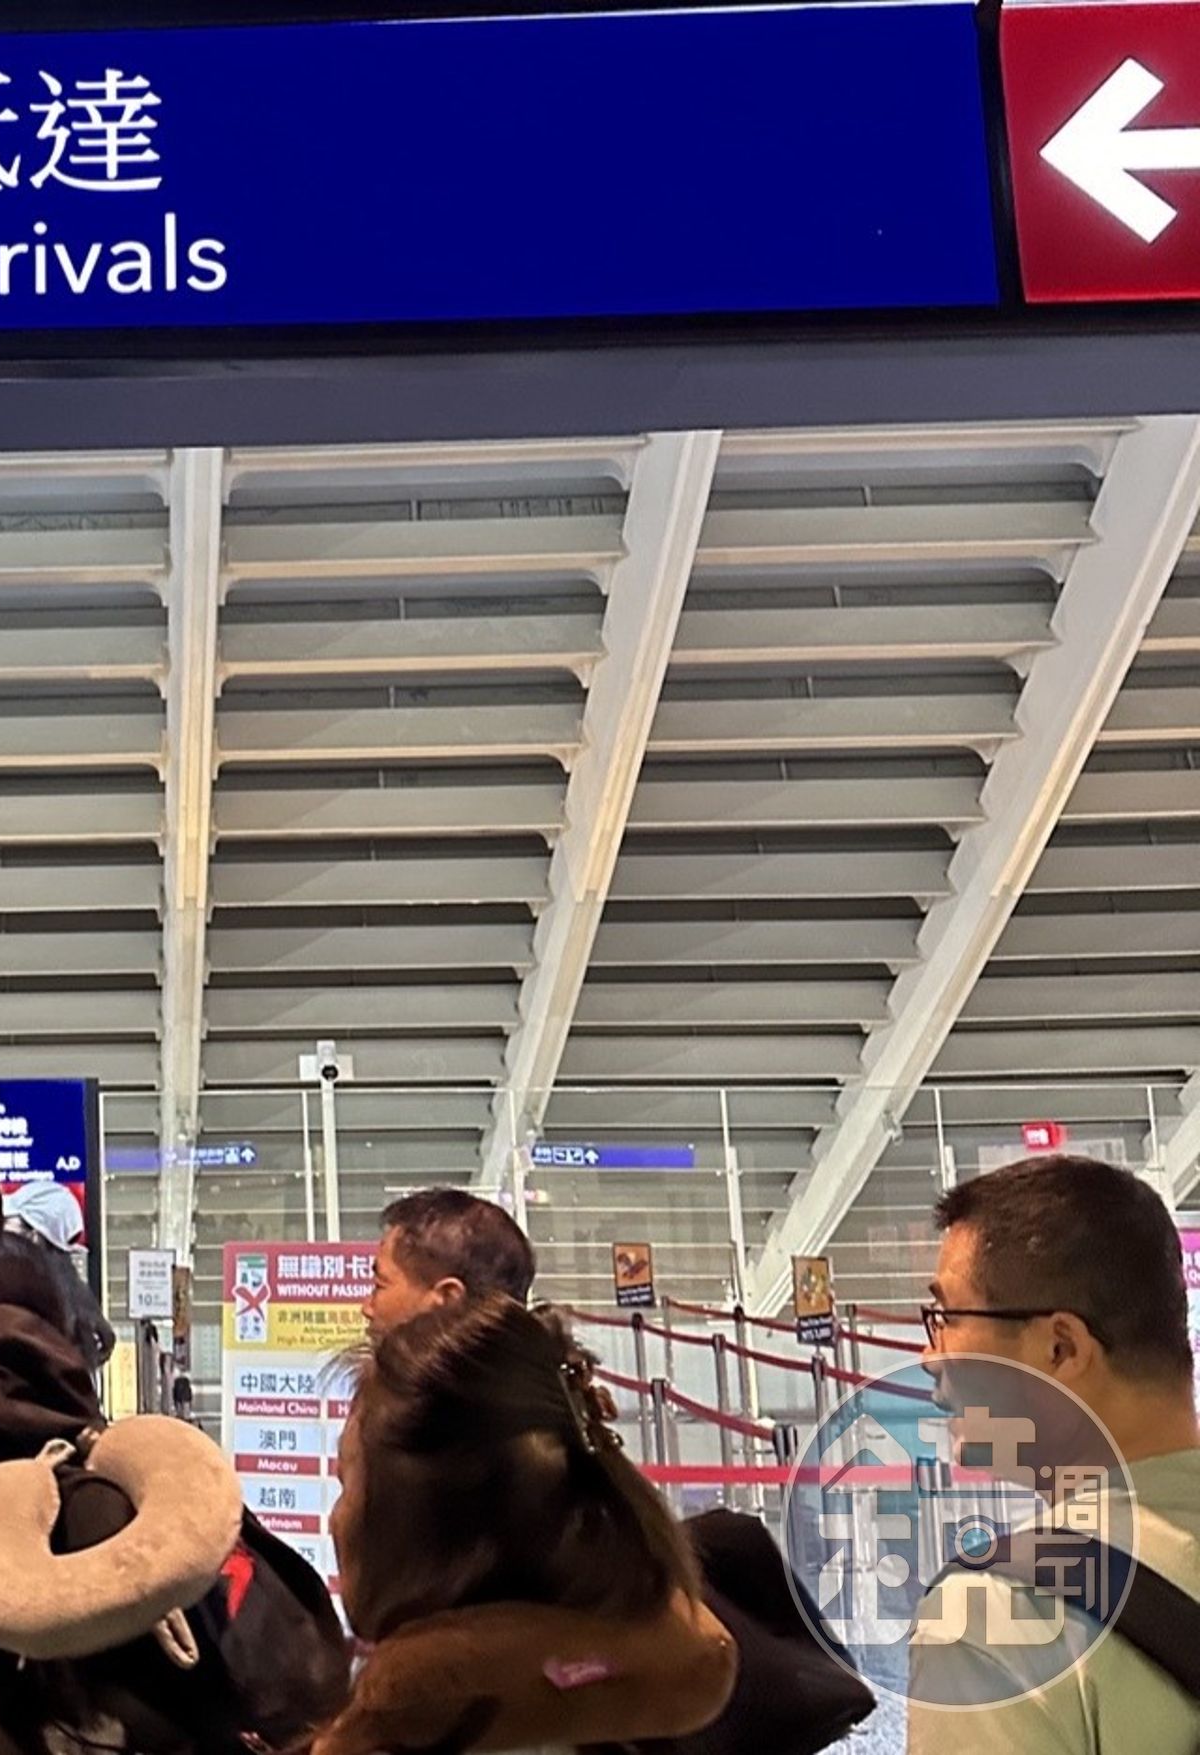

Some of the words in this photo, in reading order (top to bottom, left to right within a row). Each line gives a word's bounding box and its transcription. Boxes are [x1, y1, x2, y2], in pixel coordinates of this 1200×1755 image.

[277, 1284, 330, 1297] WITHOUT
[332, 1285, 376, 1297] PASSIN
[241, 1372, 316, 1394] 中國大陸
[238, 1402, 285, 1415] Mainland
[287, 1403, 319, 1415] China
[259, 1429, 297, 1451] 澳門
[257, 1458, 298, 1473] Macau
[259, 1486, 296, 1509] 越南
